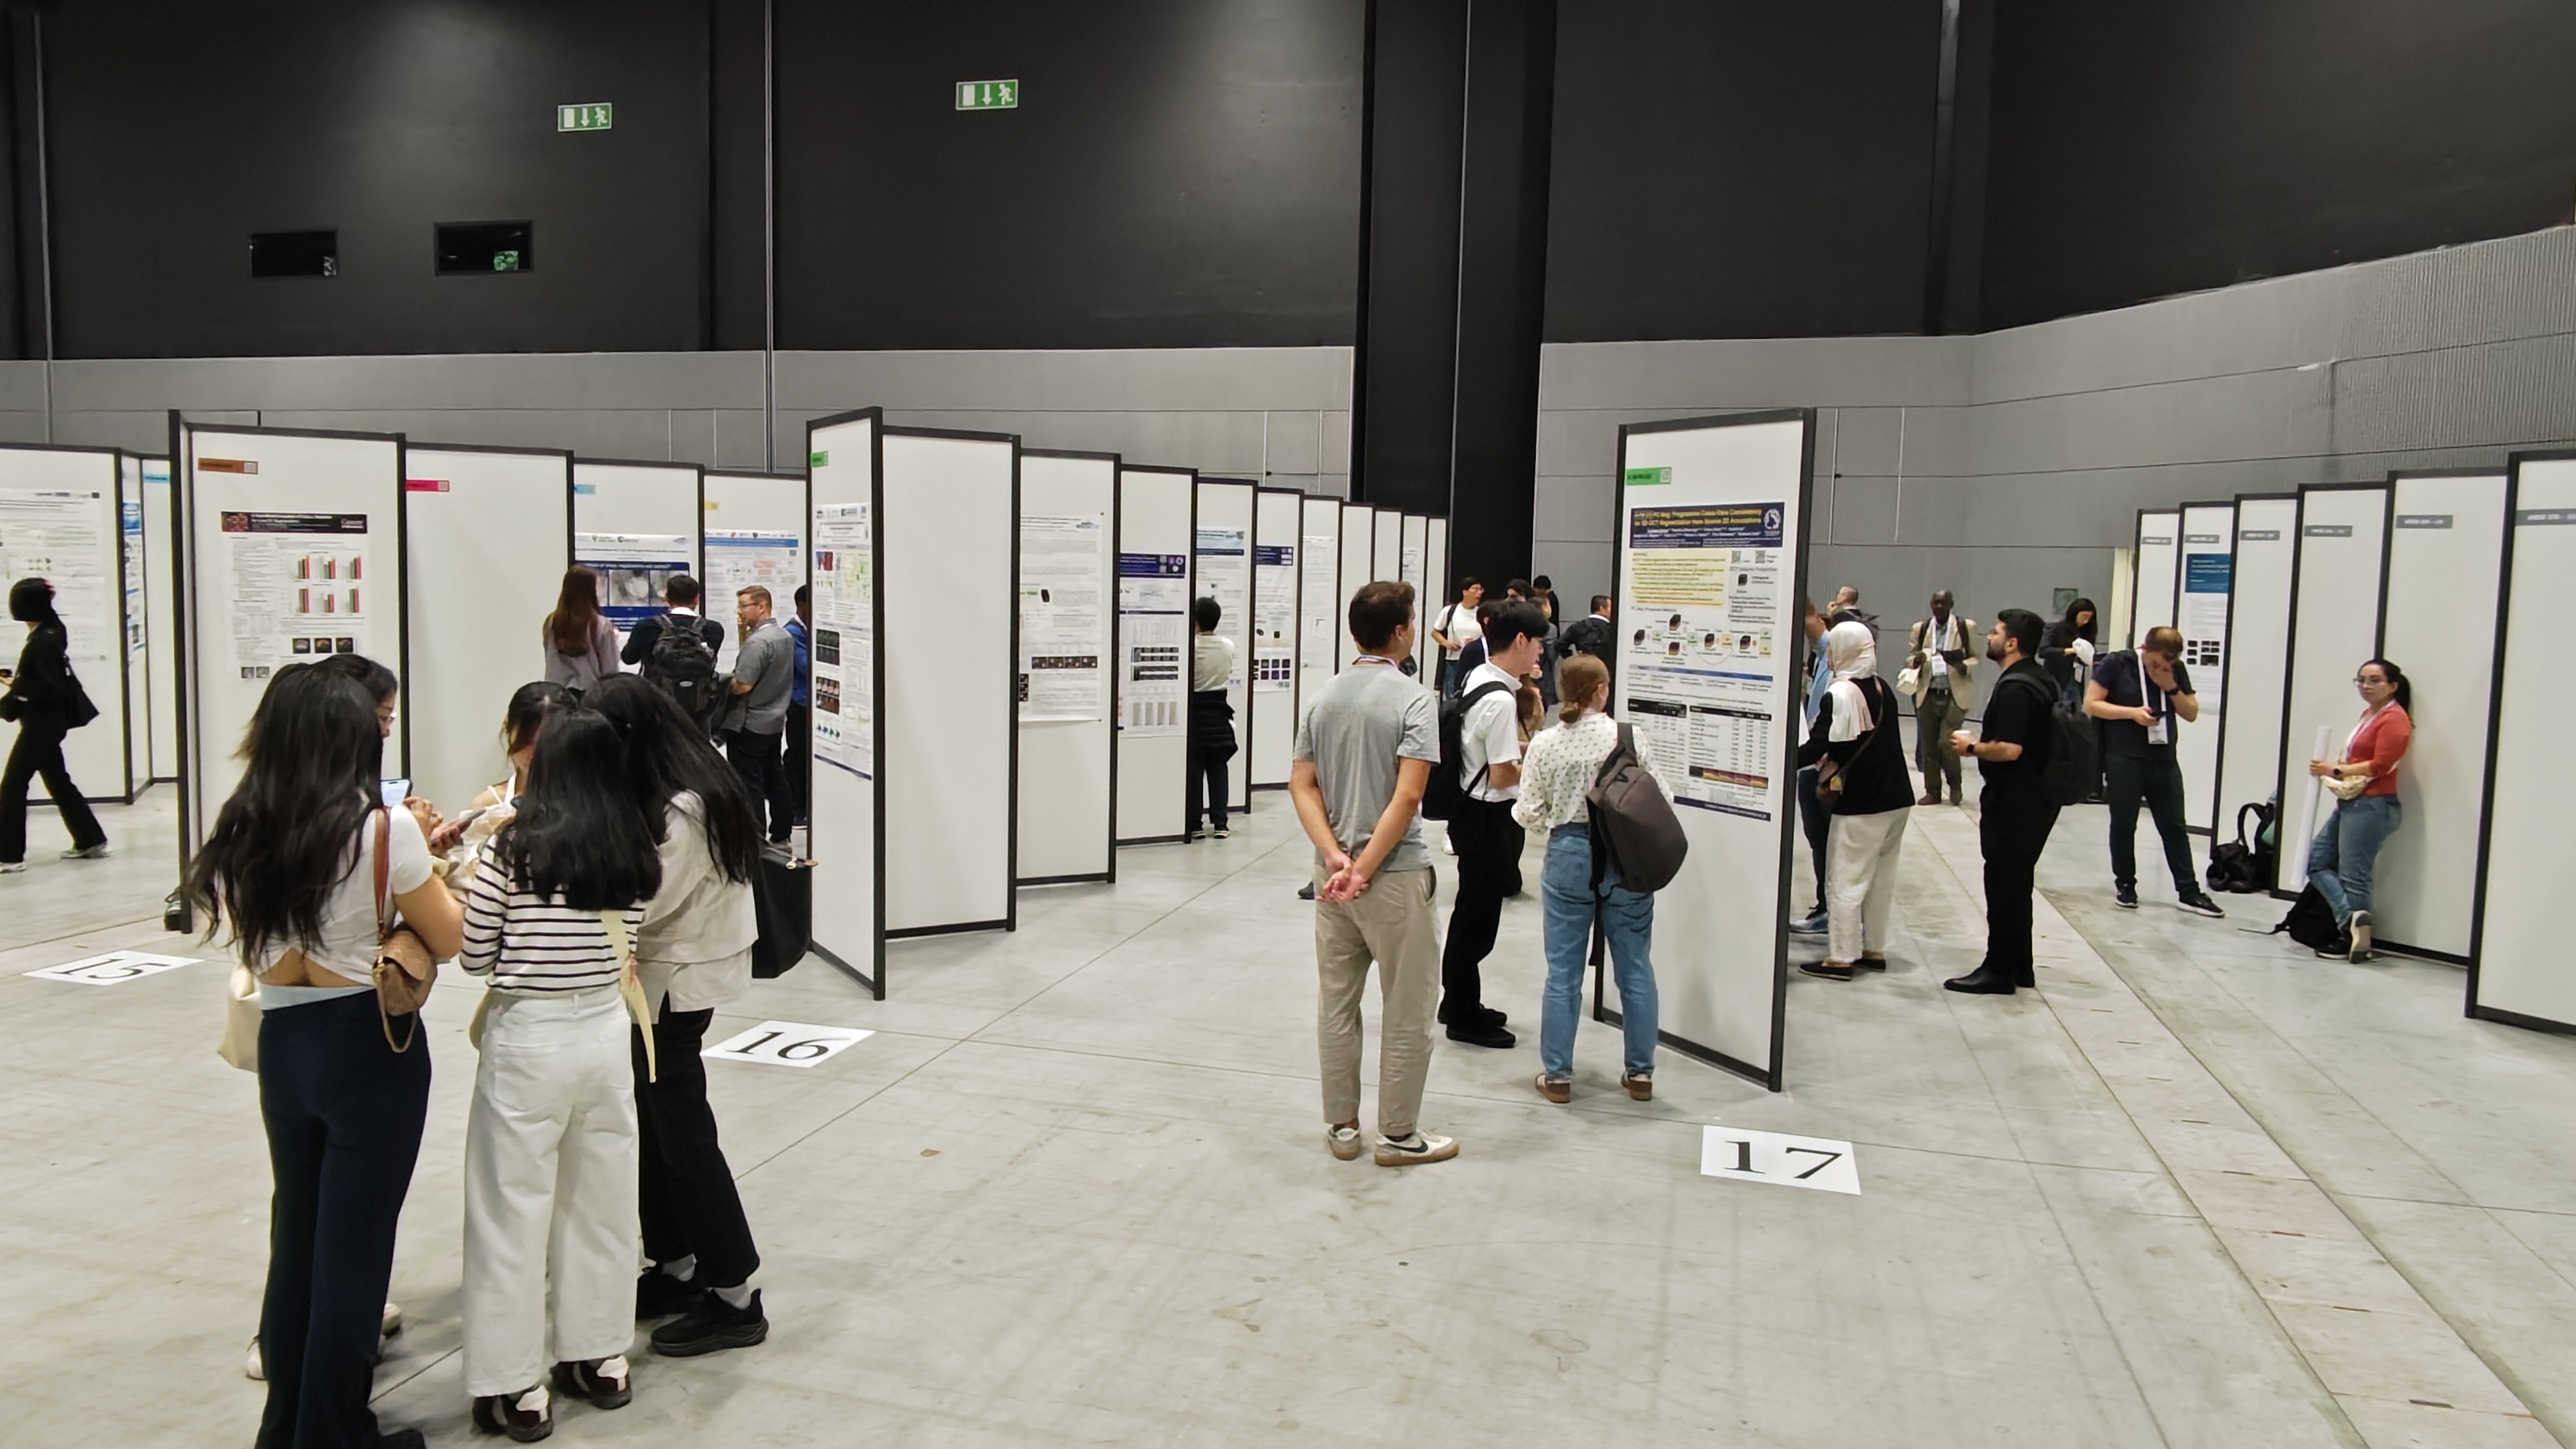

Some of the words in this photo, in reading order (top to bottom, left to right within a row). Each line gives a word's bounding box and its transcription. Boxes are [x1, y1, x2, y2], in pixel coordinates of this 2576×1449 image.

[51, 959, 170, 979] 15
[725, 1030, 851, 1060] 16
[1723, 1140, 1843, 1179] 17
